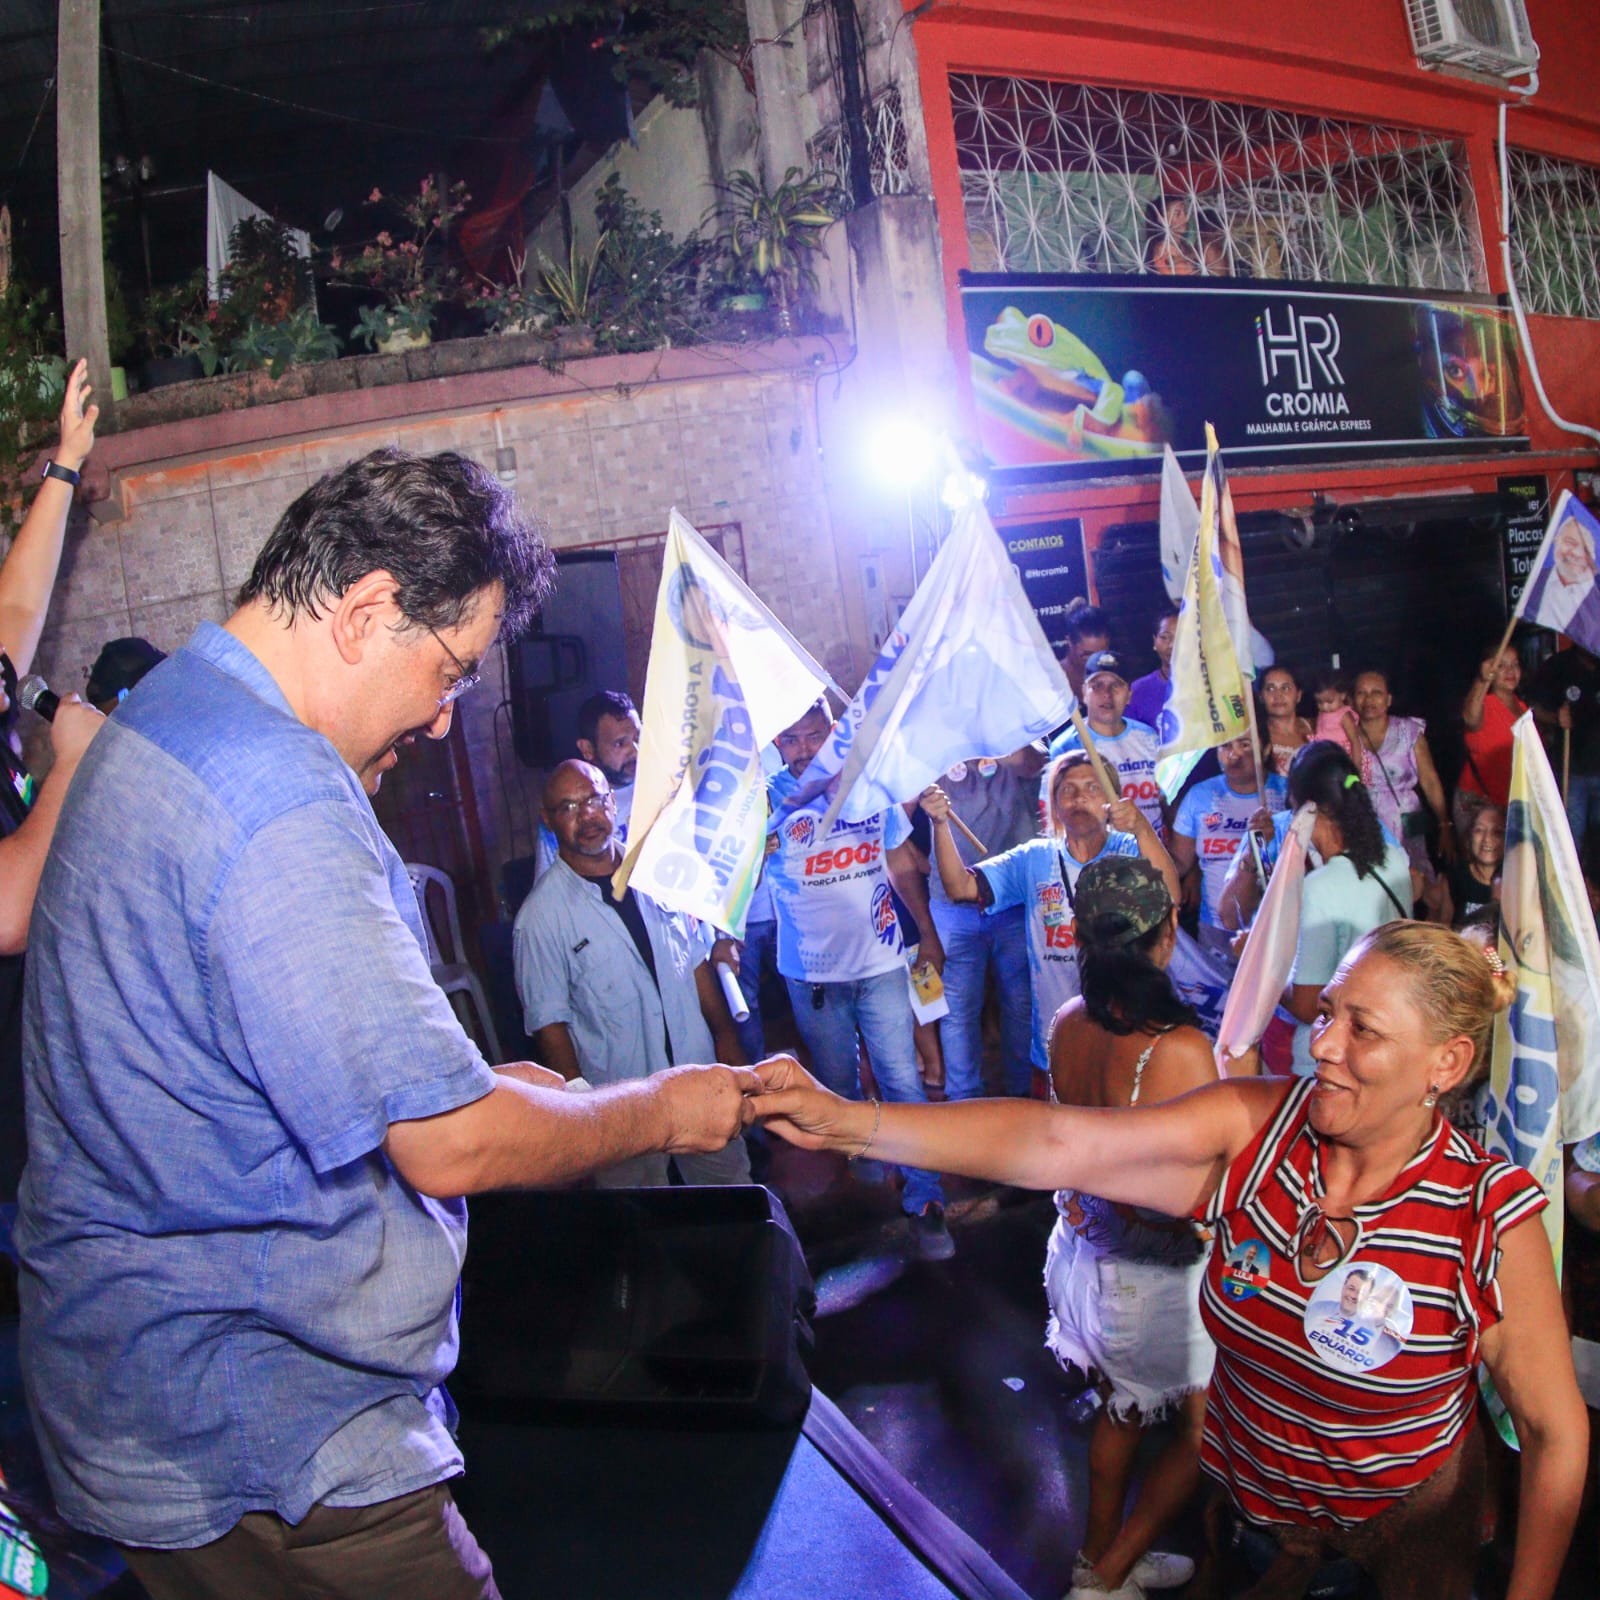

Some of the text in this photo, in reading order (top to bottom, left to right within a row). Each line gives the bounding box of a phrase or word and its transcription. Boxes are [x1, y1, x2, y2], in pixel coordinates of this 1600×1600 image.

[1256, 304, 1345, 390] HR
[1266, 392, 1350, 417] CROMIA
[1246, 418, 1372, 435] MALHARIA E GRÁFICA EXPRESS
[1008, 534, 1065, 552] CONTATOS
[1508, 528, 1544, 543] Placas
[1232, 1269, 1254, 1282] LULA
[1333, 1317, 1375, 1347] 15
[1308, 1330, 1375, 1367] EDUARDO
